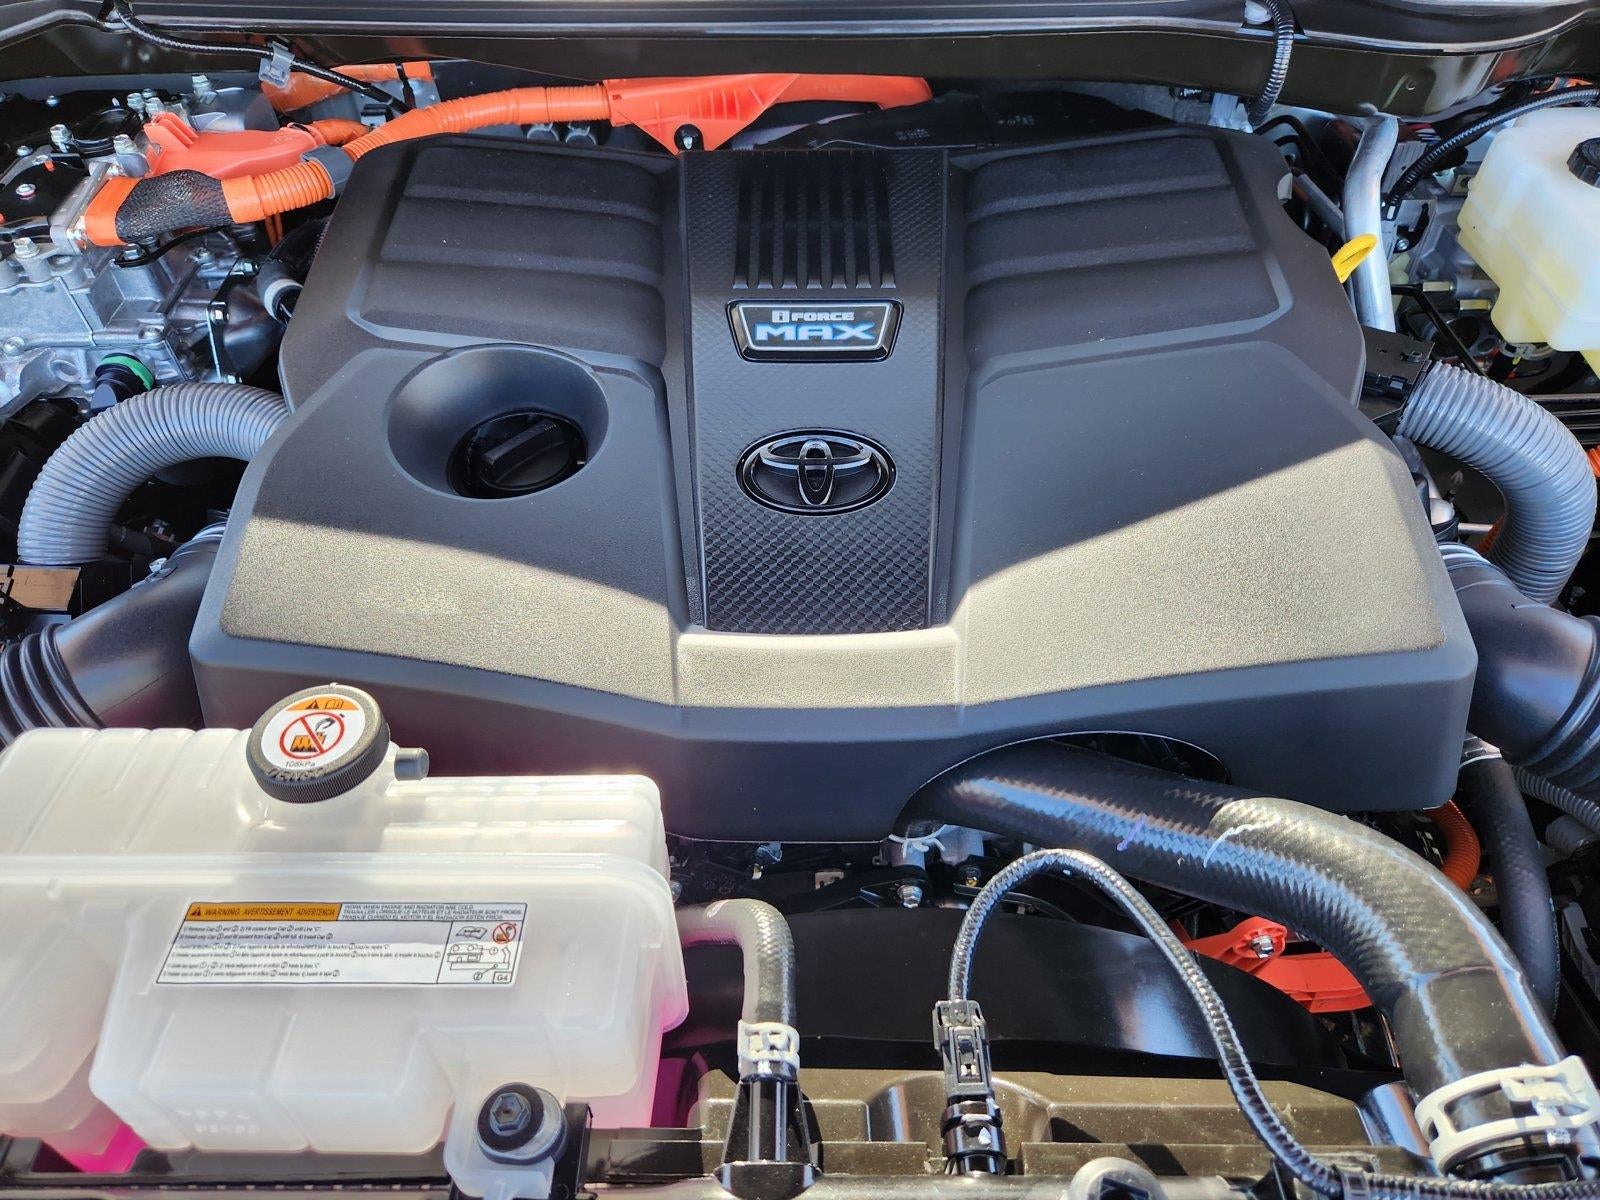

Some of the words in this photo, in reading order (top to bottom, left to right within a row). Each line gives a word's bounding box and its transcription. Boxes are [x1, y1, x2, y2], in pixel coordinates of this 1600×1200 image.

[755, 323, 875, 340] MAX
[205, 907, 240, 916] WARNING
[243, 907, 294, 916] AVERTISSEMENT
[297, 907, 335, 916] ADVERTENCIA
